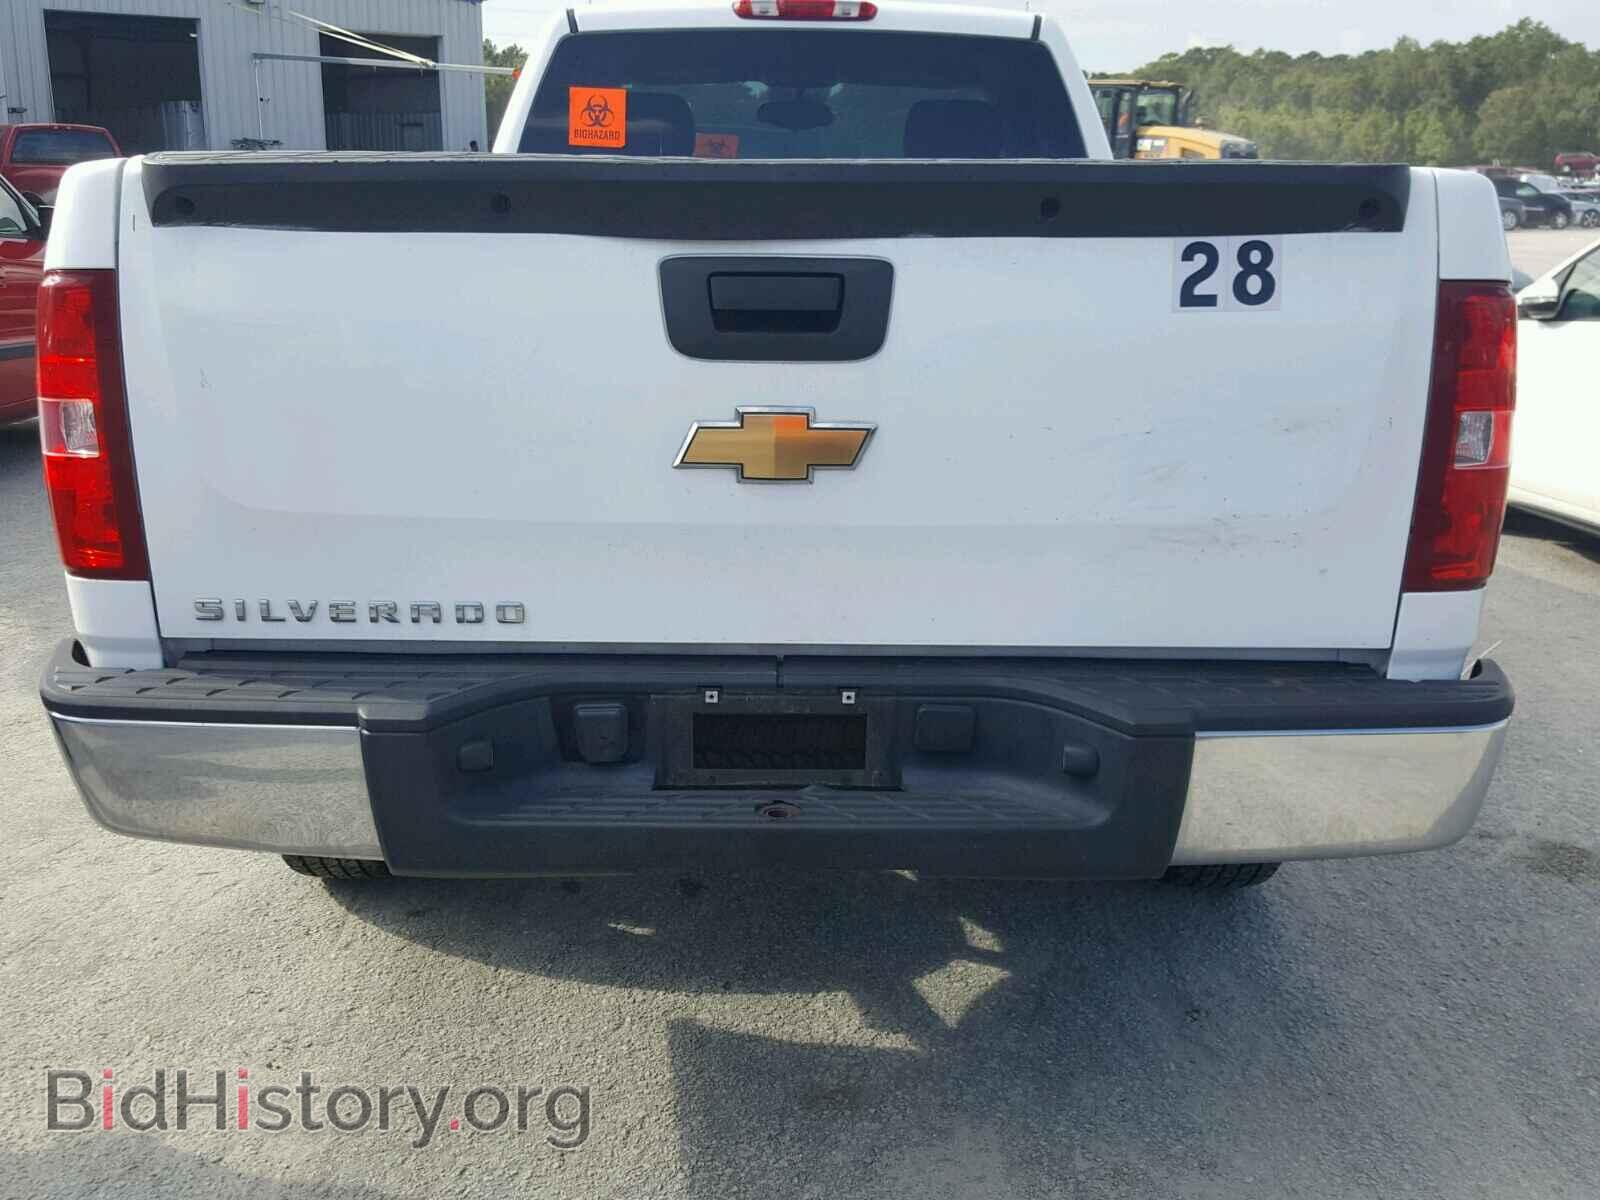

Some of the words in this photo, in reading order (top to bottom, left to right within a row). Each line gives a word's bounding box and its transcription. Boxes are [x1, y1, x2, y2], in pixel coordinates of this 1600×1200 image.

[574, 128, 621, 141] BIOHAZARD
[1180, 240, 1276, 308] 28
[193, 598, 526, 624] SILVERADO
